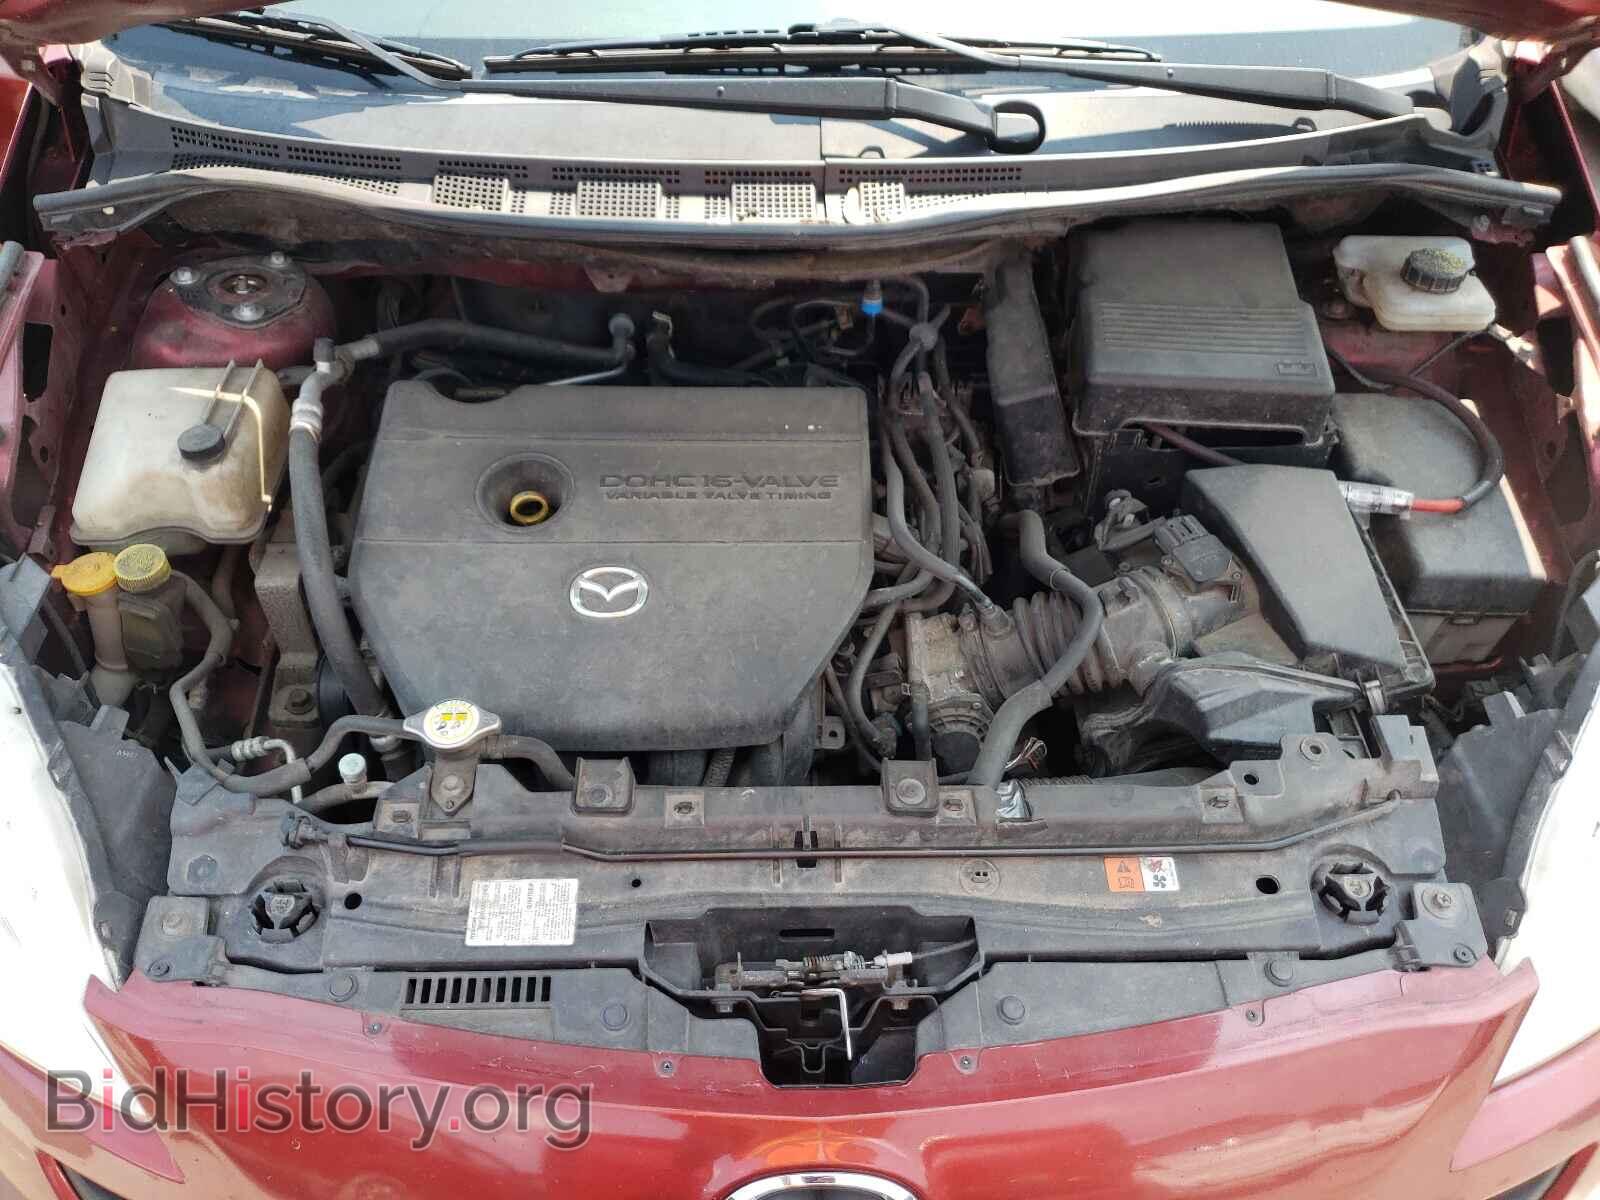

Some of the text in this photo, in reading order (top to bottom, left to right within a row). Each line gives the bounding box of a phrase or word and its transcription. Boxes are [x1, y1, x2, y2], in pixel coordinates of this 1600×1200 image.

[600, 474, 840, 488] DOHC 16-VALVE
[606, 490, 832, 500] VARIABLE VALVE TIMING
